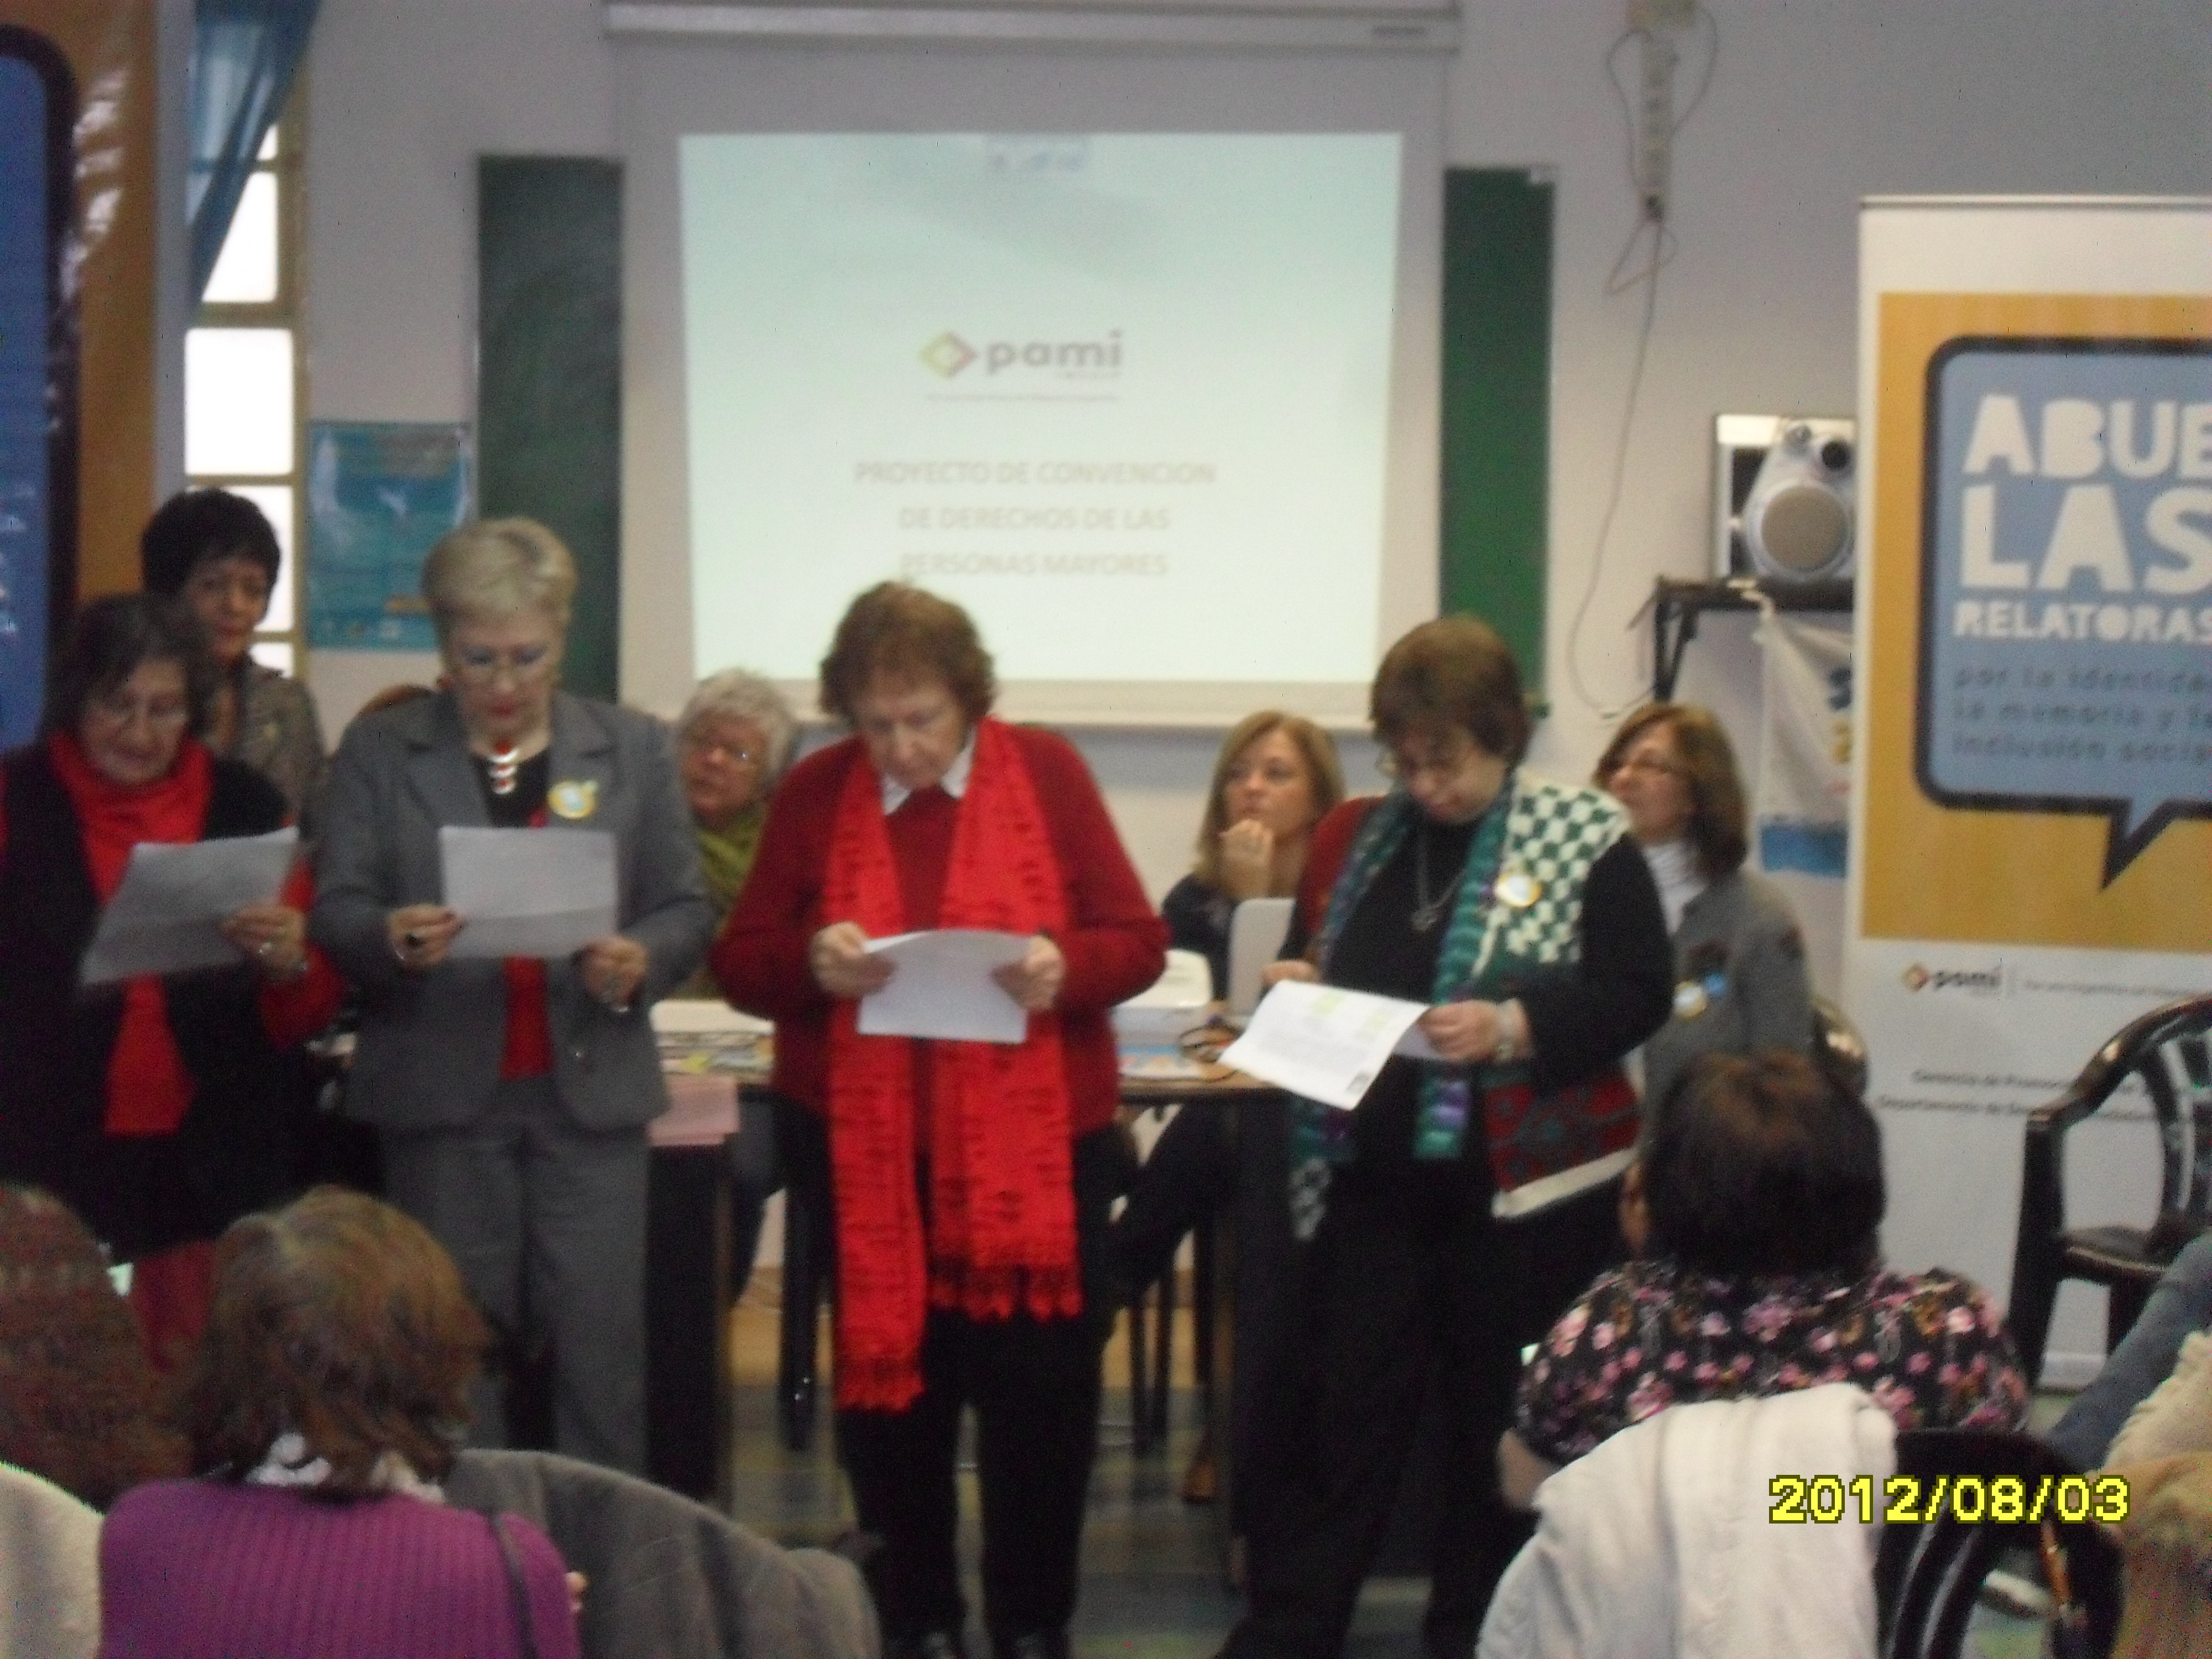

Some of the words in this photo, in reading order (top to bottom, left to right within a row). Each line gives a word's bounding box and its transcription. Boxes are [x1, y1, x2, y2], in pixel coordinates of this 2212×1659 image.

[985, 330, 1123, 374] pami
[853, 461, 991, 484] PROYECTO
[995, 462, 1029, 484] DE
[898, 507, 932, 529] DE
[939, 507, 1077, 530] DERECHOS
[1083, 507, 1117, 529] DE
[1124, 507, 1171, 529] LAS
[1961, 484, 2212, 596] LAS
[900, 553, 1037, 576] PERSONAS
[1042, 553, 1169, 576] MAYORES
